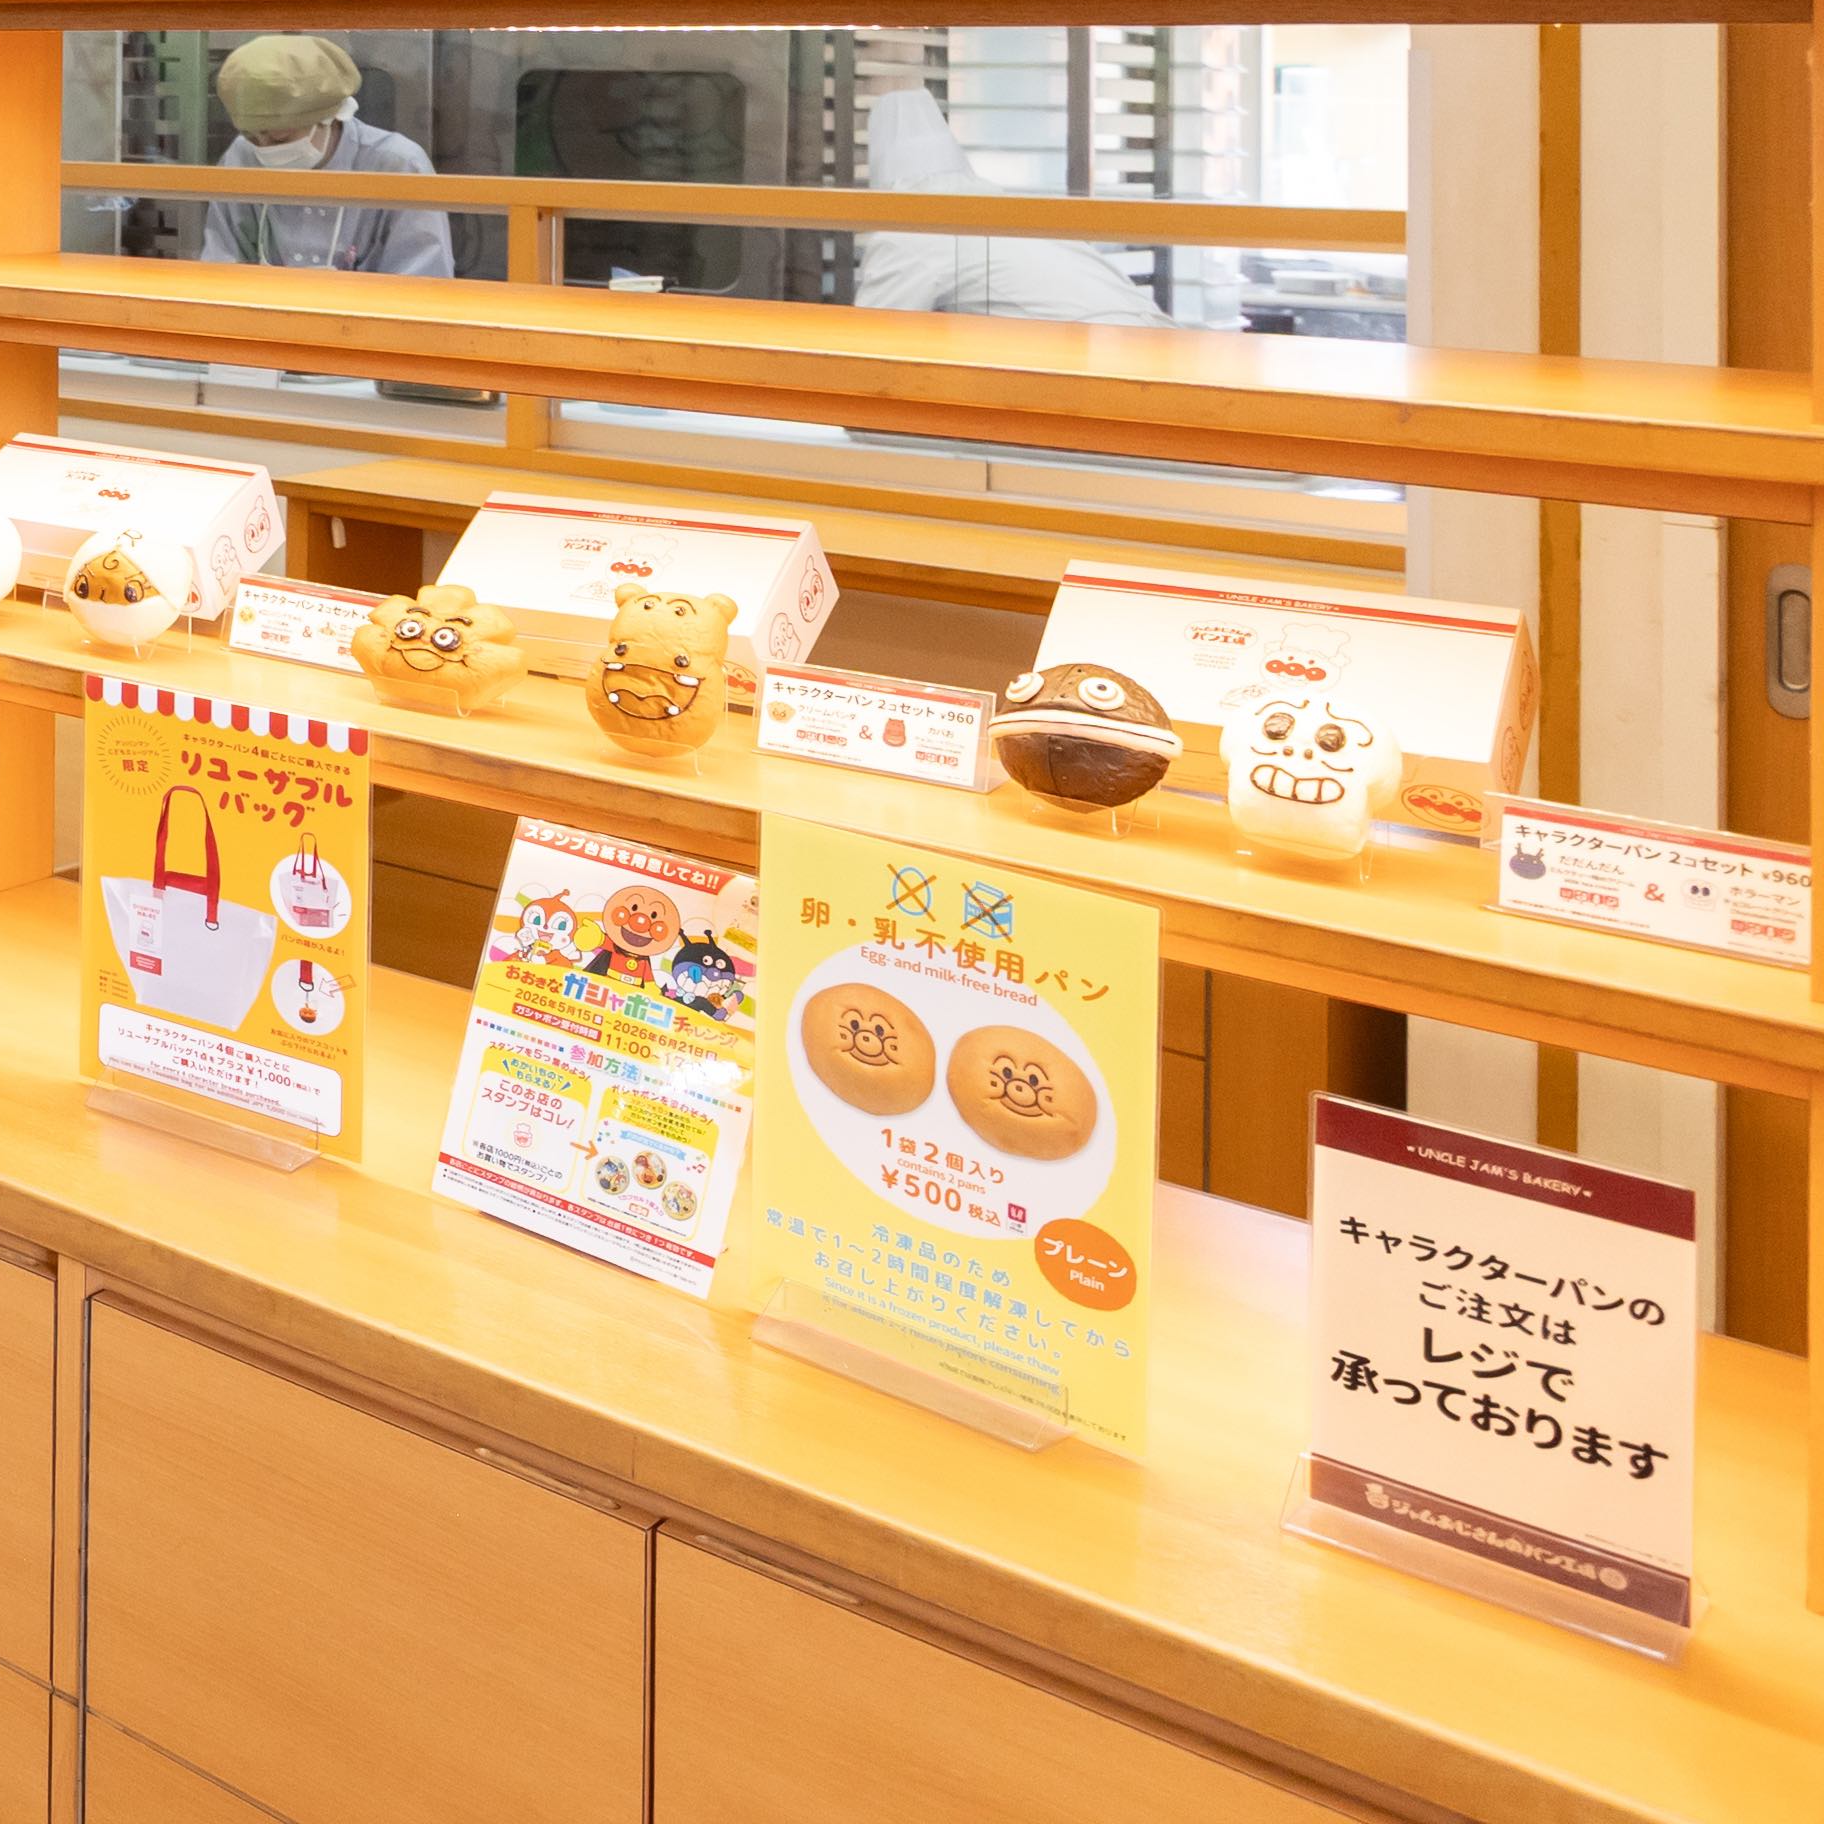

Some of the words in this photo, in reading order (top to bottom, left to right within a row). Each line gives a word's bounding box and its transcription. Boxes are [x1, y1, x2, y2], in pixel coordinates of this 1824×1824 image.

[244, 590, 314, 609] キャラクターパン
[1226, 593, 1258, 604] UNCLE
[1294, 601, 1333, 612] BAKERY
[302, 626, 312, 638] &
[773, 682, 873, 706] キャラクターパン
[878, 699, 935, 717] 2コセット
[940, 711, 975, 725] ¥960
[859, 725, 873, 740] &
[122, 759, 150, 773] 限定
[183, 733, 350, 776] キャラクターパン4個ごとにご購入できる
[181, 750, 353, 808] リユーザブル
[219, 792, 315, 827] バッグ
[524, 825, 720, 889] スタンプ台紙を用意してね!!
[1515, 825, 1662, 860] キャラクターパン
[1668, 851, 1753, 877] 2コセット
[1644, 882, 1665, 903] &
[1729, 885, 1801, 907] ホラーマン
[801, 897, 1109, 1002] 卵・乳不使用パン
[861, 945, 890, 968] Egg-
[894, 956, 922, 974] and
[924, 964, 991, 991] milk-free
[993, 982, 1038, 1008] bread
[514, 1005, 601, 1041] ガシャポン受付時間
[145, 1023, 290, 1073] キャラクターパン4個ご購入ごとに
[570, 1044, 642, 1083] 参加方法
[172, 1055, 259, 1088] ご購入いただけます!
[481, 1087, 575, 1129] スタンプはコレ!
[499, 1079, 563, 1110] このお店の
[881, 1128, 1005, 1185] 1袋2個入り
[897, 1157, 946, 1180] contains
[948, 1173, 956, 1184] 2
[957, 1177, 986, 1195] pans
[1418, 1146, 1466, 1168] UNCLE
[1470, 1159, 1519, 1181] JAM'S
[1523, 1172, 1582, 1197] BAKERY
[881, 1164, 962, 1213] ¥500
[968, 1203, 1001, 1227] 税込
[871, 1222, 1012, 1289] 冷凍品のため
[1042, 1237, 1128, 1279] プレーン
[1339, 1216, 1666, 1327] キャラクターパンの
[824, 1276, 855, 1298] Since
[889, 1300, 926, 1324] frozen
[1069, 1269, 1106, 1292] Plain
[813, 1250, 1062, 1360] お召し上がりください。
[1418, 1280, 1577, 1347] ご注文は
[1421, 1326, 1574, 1403] レジで
[1330, 1348, 1669, 1480] 承っております
[1391, 1498, 1598, 1581] ジャムおじさんのパン工場
